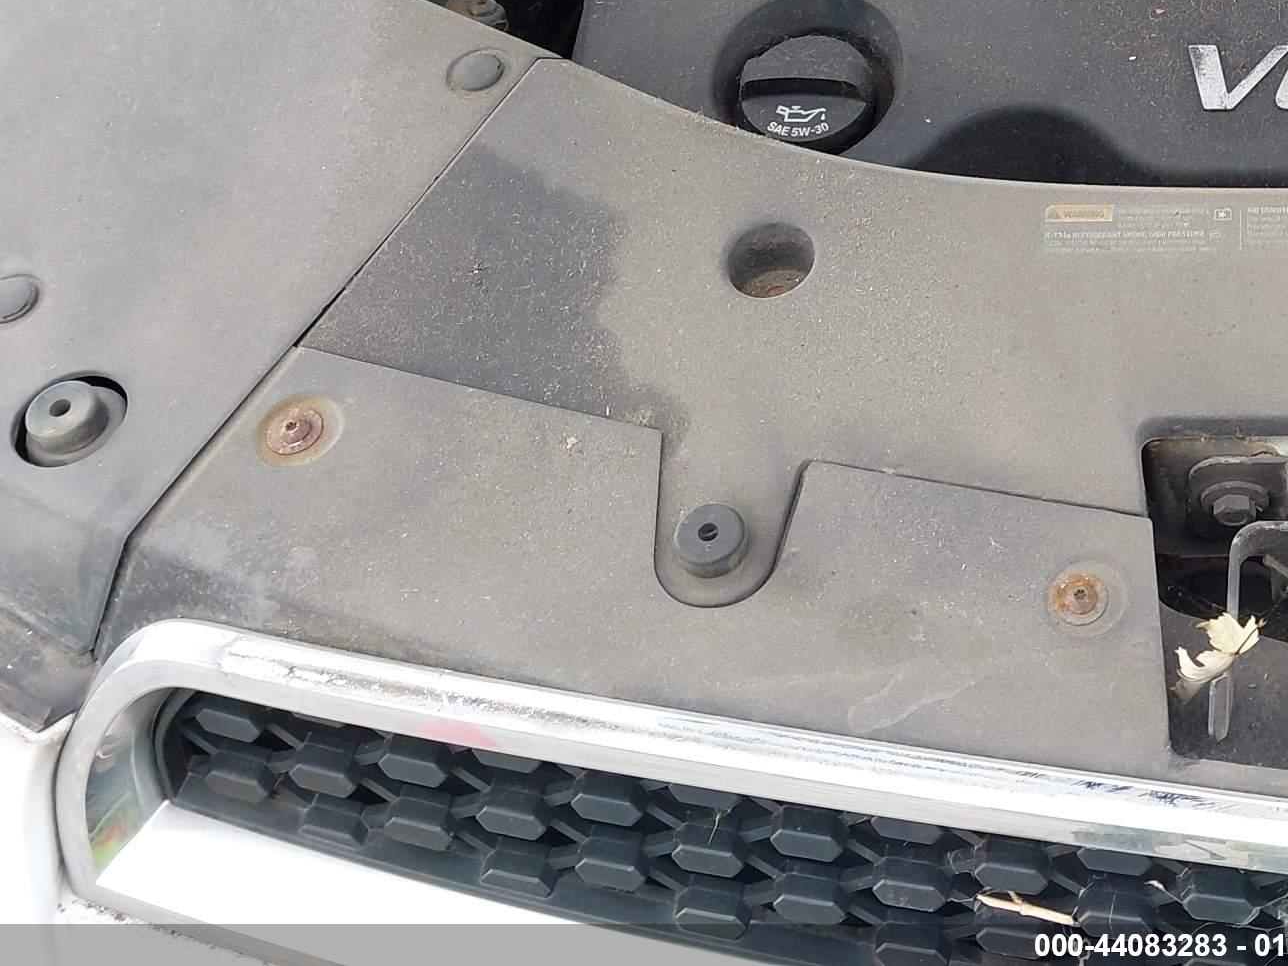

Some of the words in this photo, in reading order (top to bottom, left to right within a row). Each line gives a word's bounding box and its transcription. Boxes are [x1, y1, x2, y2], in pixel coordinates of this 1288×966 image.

[767, 121, 790, 136] SAE
[791, 121, 830, 137] 5W-30
[1063, 210, 1105, 219] WARNING
